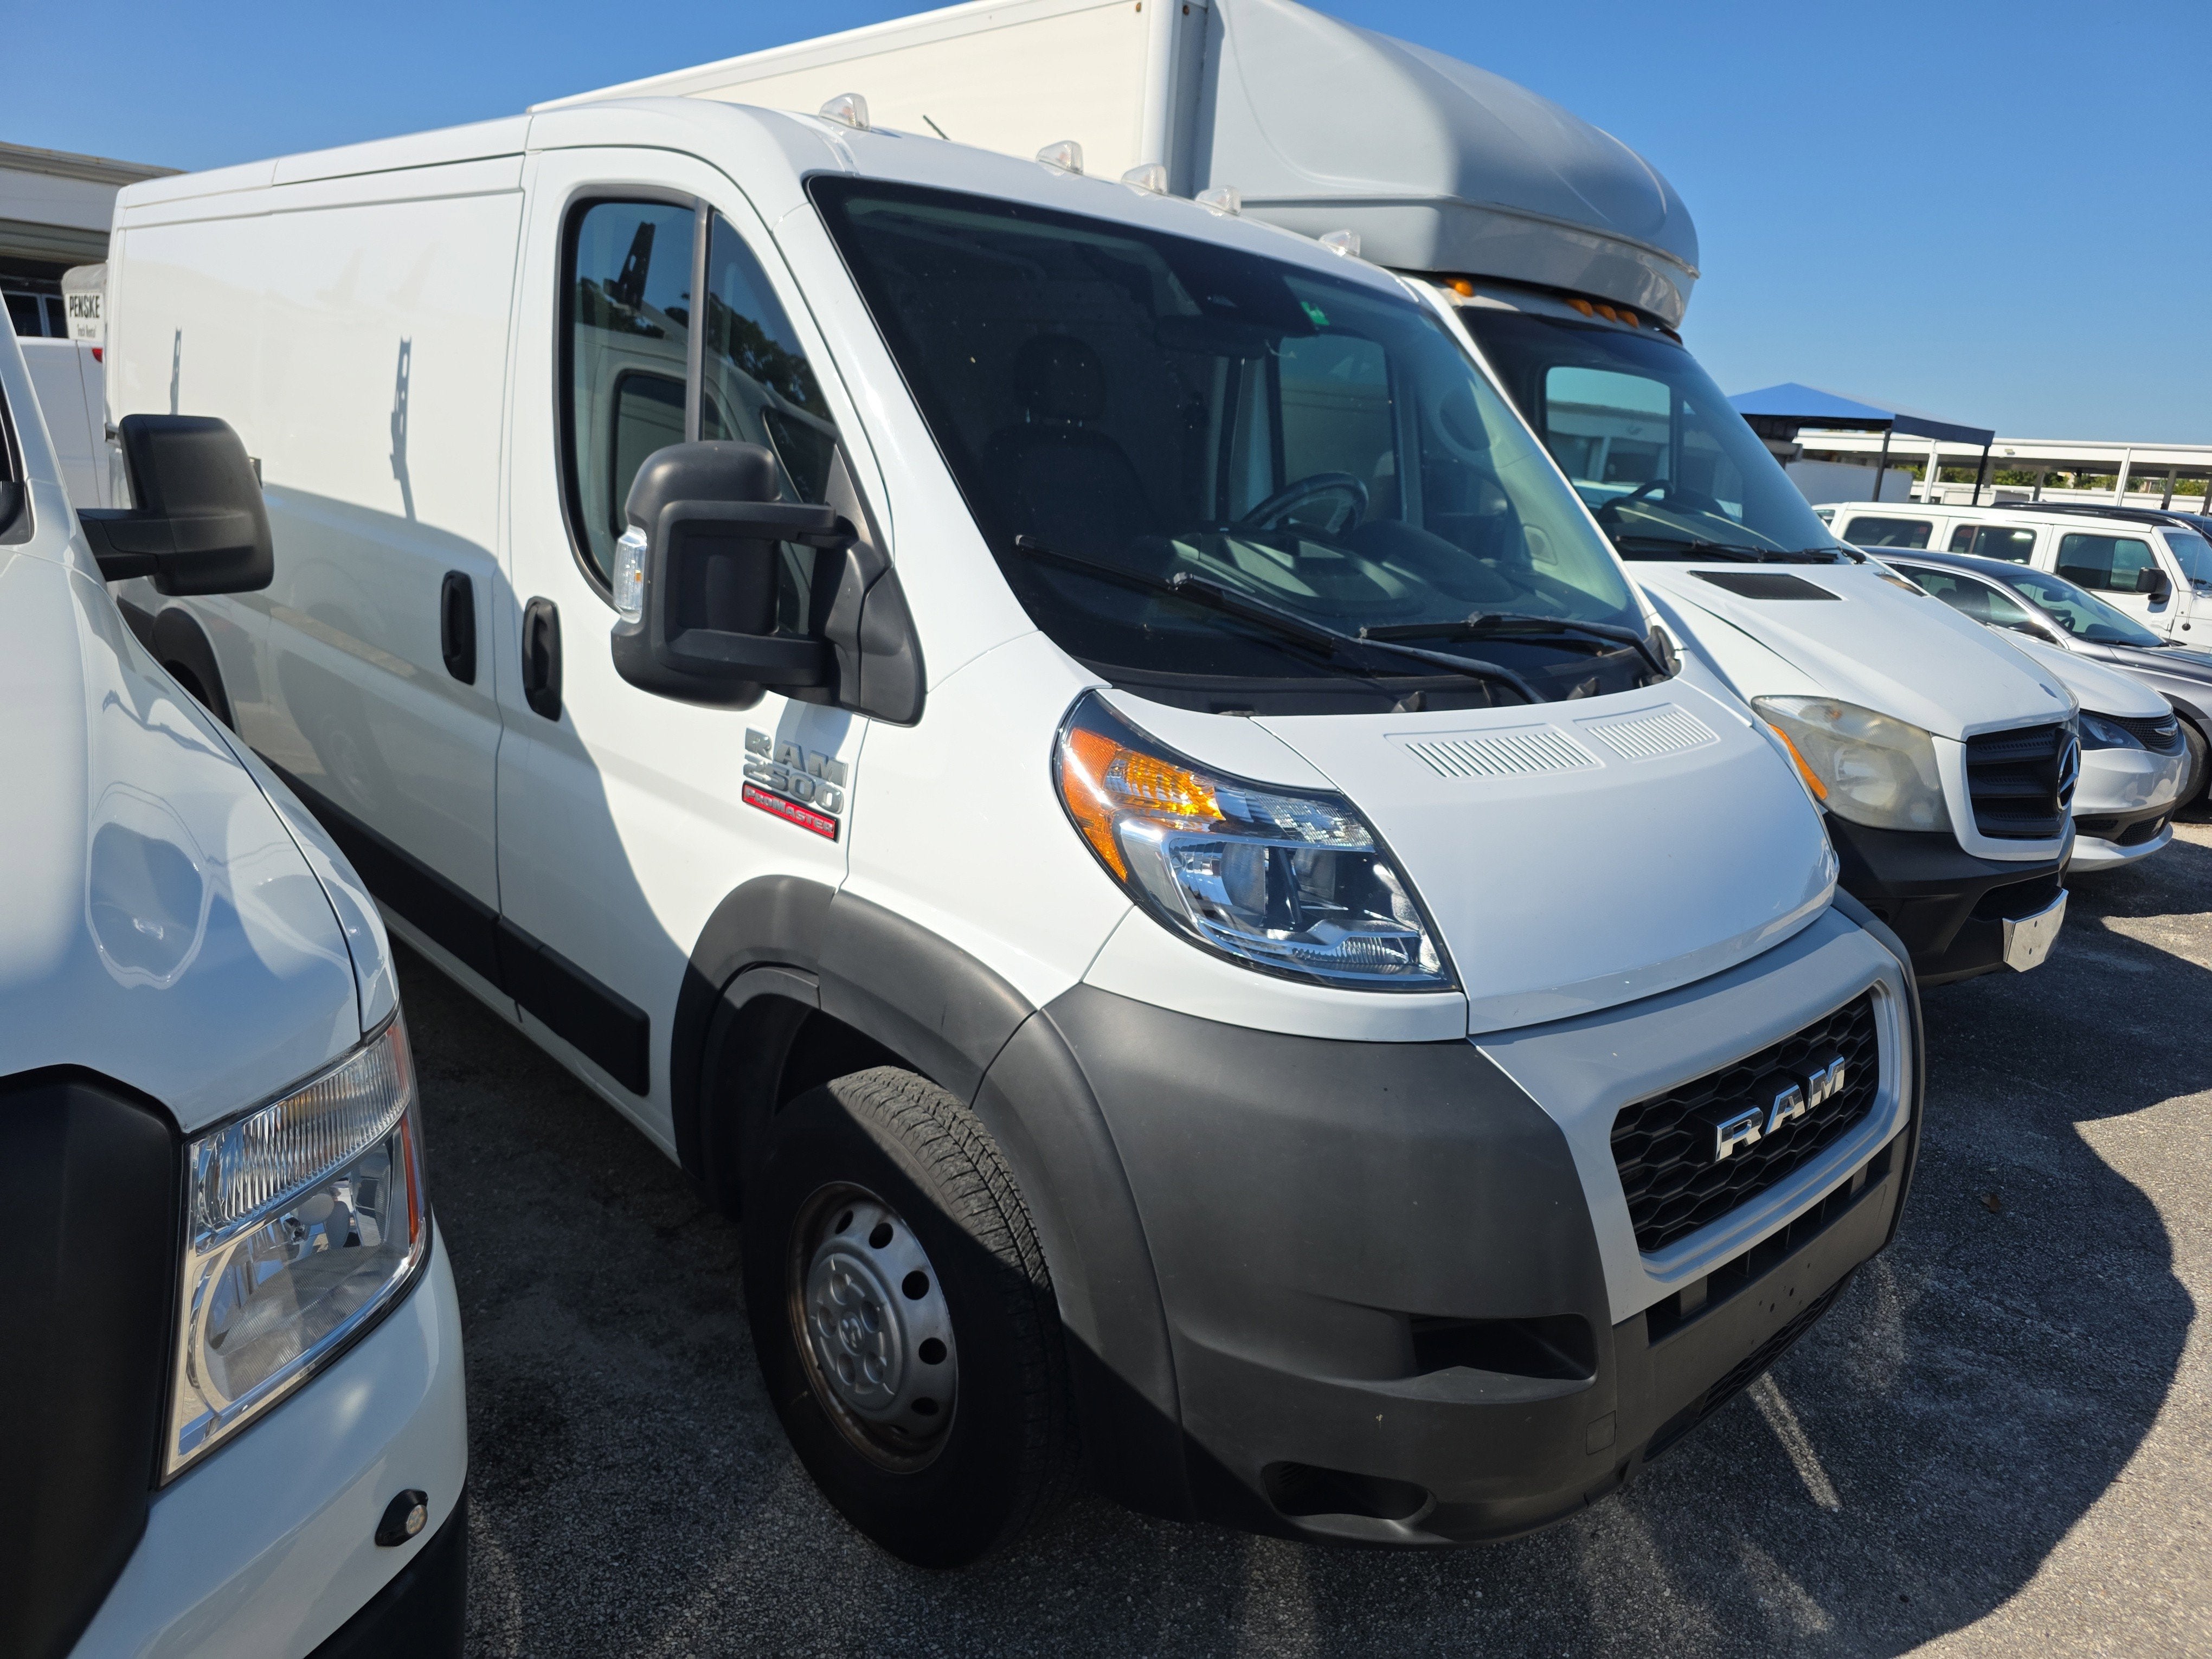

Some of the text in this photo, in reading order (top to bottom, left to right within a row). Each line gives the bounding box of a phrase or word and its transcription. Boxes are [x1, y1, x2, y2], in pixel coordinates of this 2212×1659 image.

[69, 294, 100, 318] PENSKE
[743, 754, 844, 814] 2500
[745, 727, 848, 788] RAM
[1715, 1056, 1845, 1161] RAM
